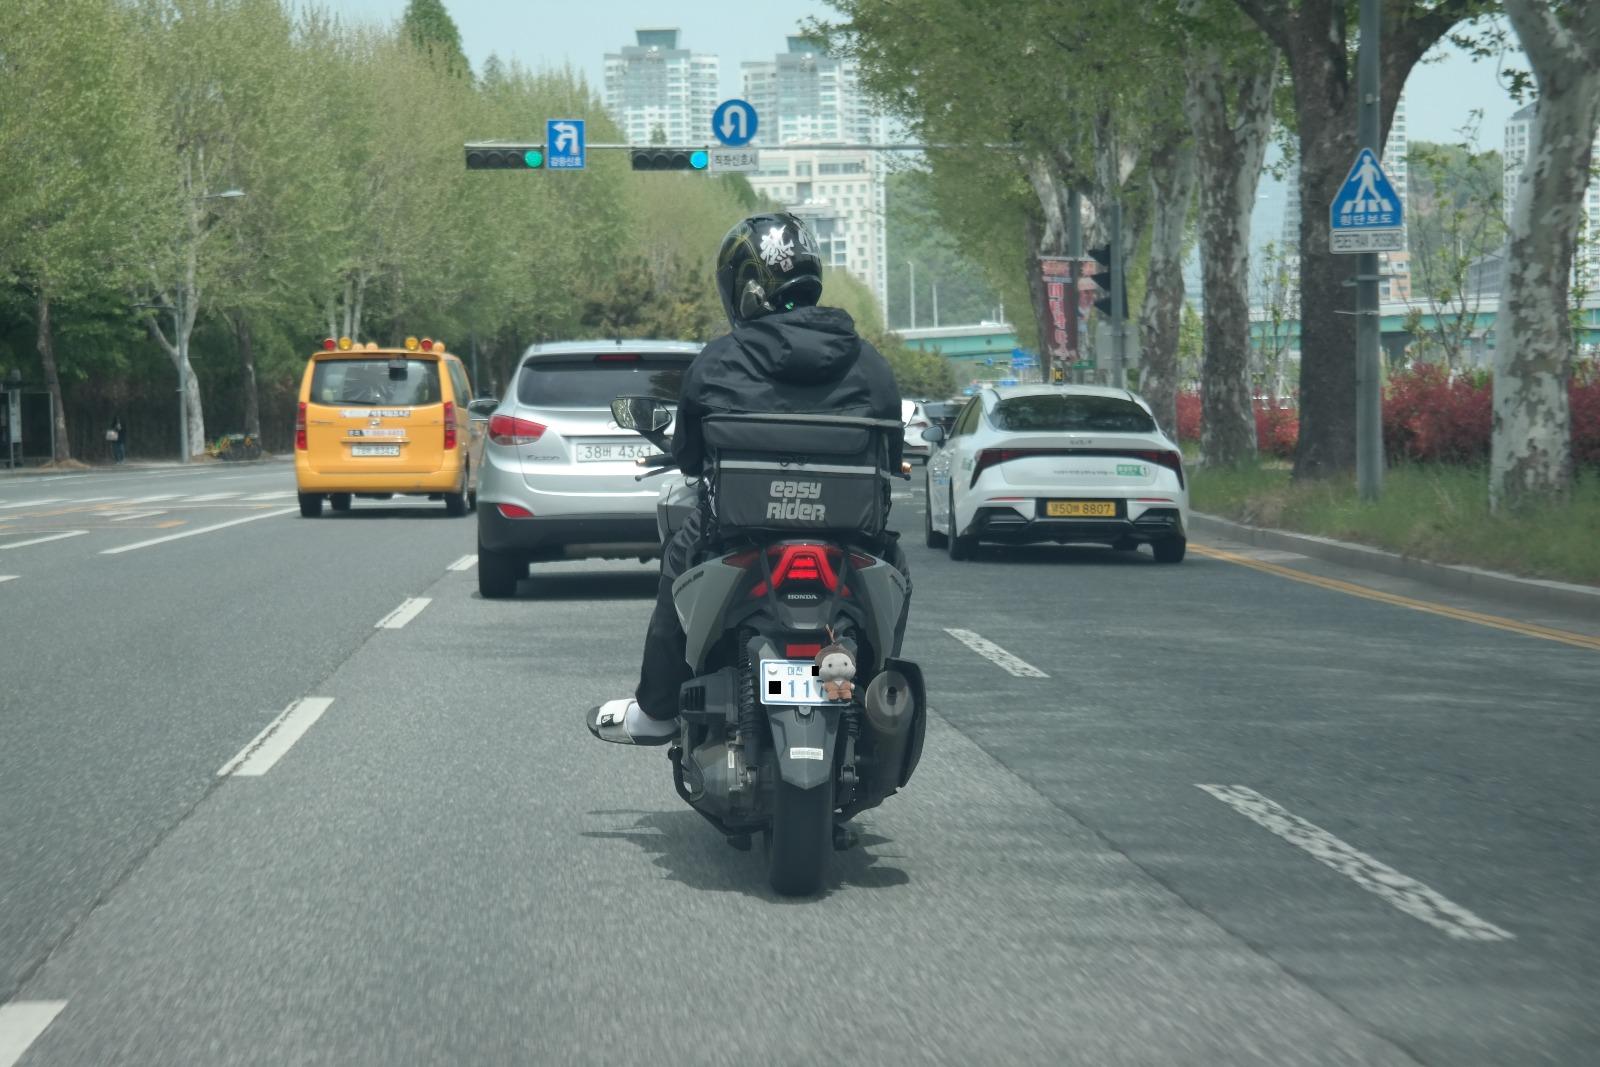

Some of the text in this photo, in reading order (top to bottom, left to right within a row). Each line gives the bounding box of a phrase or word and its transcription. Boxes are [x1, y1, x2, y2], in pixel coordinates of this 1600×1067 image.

[715, 153, 757, 167] 직좌신호시
[1340, 214, 1393, 226] 횡단보도
[585, 446, 612, 459] 38버
[770, 481, 821, 499] easy
[1082, 503, 1111, 514] 8807
